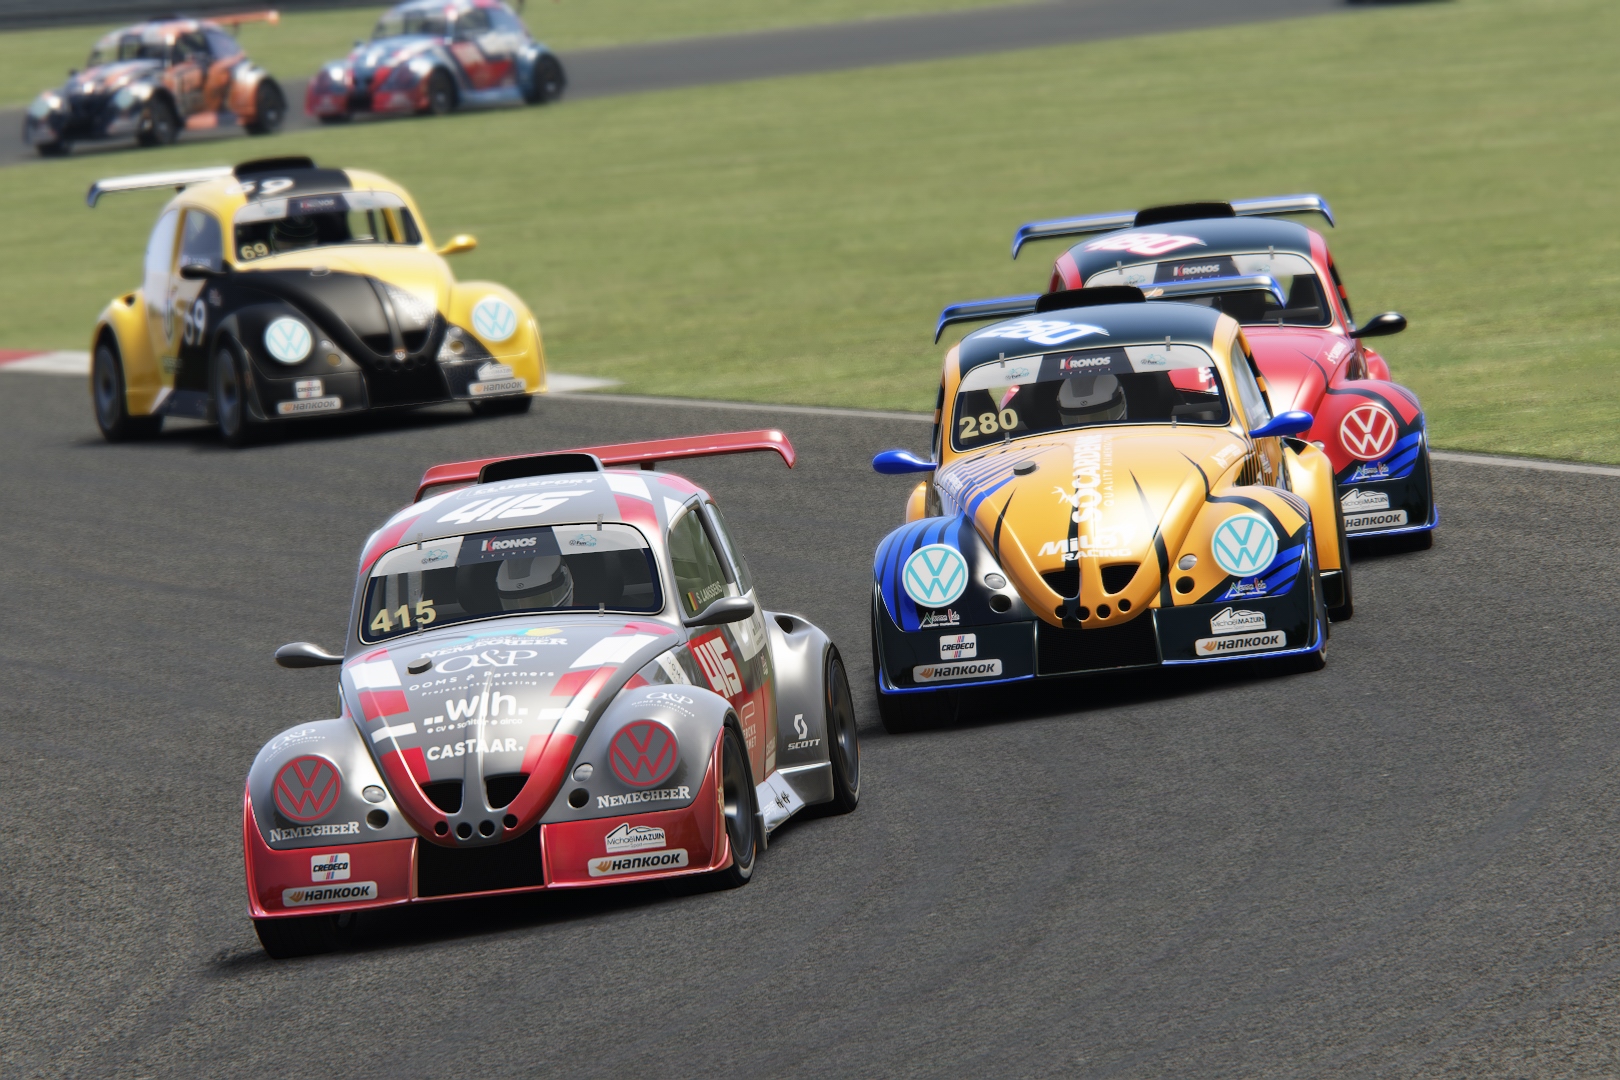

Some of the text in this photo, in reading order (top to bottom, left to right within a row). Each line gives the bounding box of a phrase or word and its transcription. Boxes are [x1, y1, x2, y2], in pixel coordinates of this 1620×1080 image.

[241, 243, 268, 259] 69
[1173, 264, 1220, 277] KRONOS
[973, 320, 1106, 346] 280
[1060, 355, 1111, 370] KRONOS
[959, 409, 1018, 439] 280
[436, 490, 595, 525] 415
[481, 535, 537, 552] KRONOS
[1061, 548, 1132, 562] RACING
[369, 599, 437, 633] 415
[941, 642, 975, 651] CREDECO
[693, 636, 743, 699] 415
[409, 676, 458, 691] OOMS
[484, 671, 555, 679] Partners
[500, 718, 523, 726] airco
[787, 738, 821, 751] SCOTT
[596, 786, 691, 809] NEMEGHEER
[269, 821, 360, 843] NEMEGHEER
[635, 832, 665, 842] MAZUIN
[312, 861, 349, 873] CREDECO
